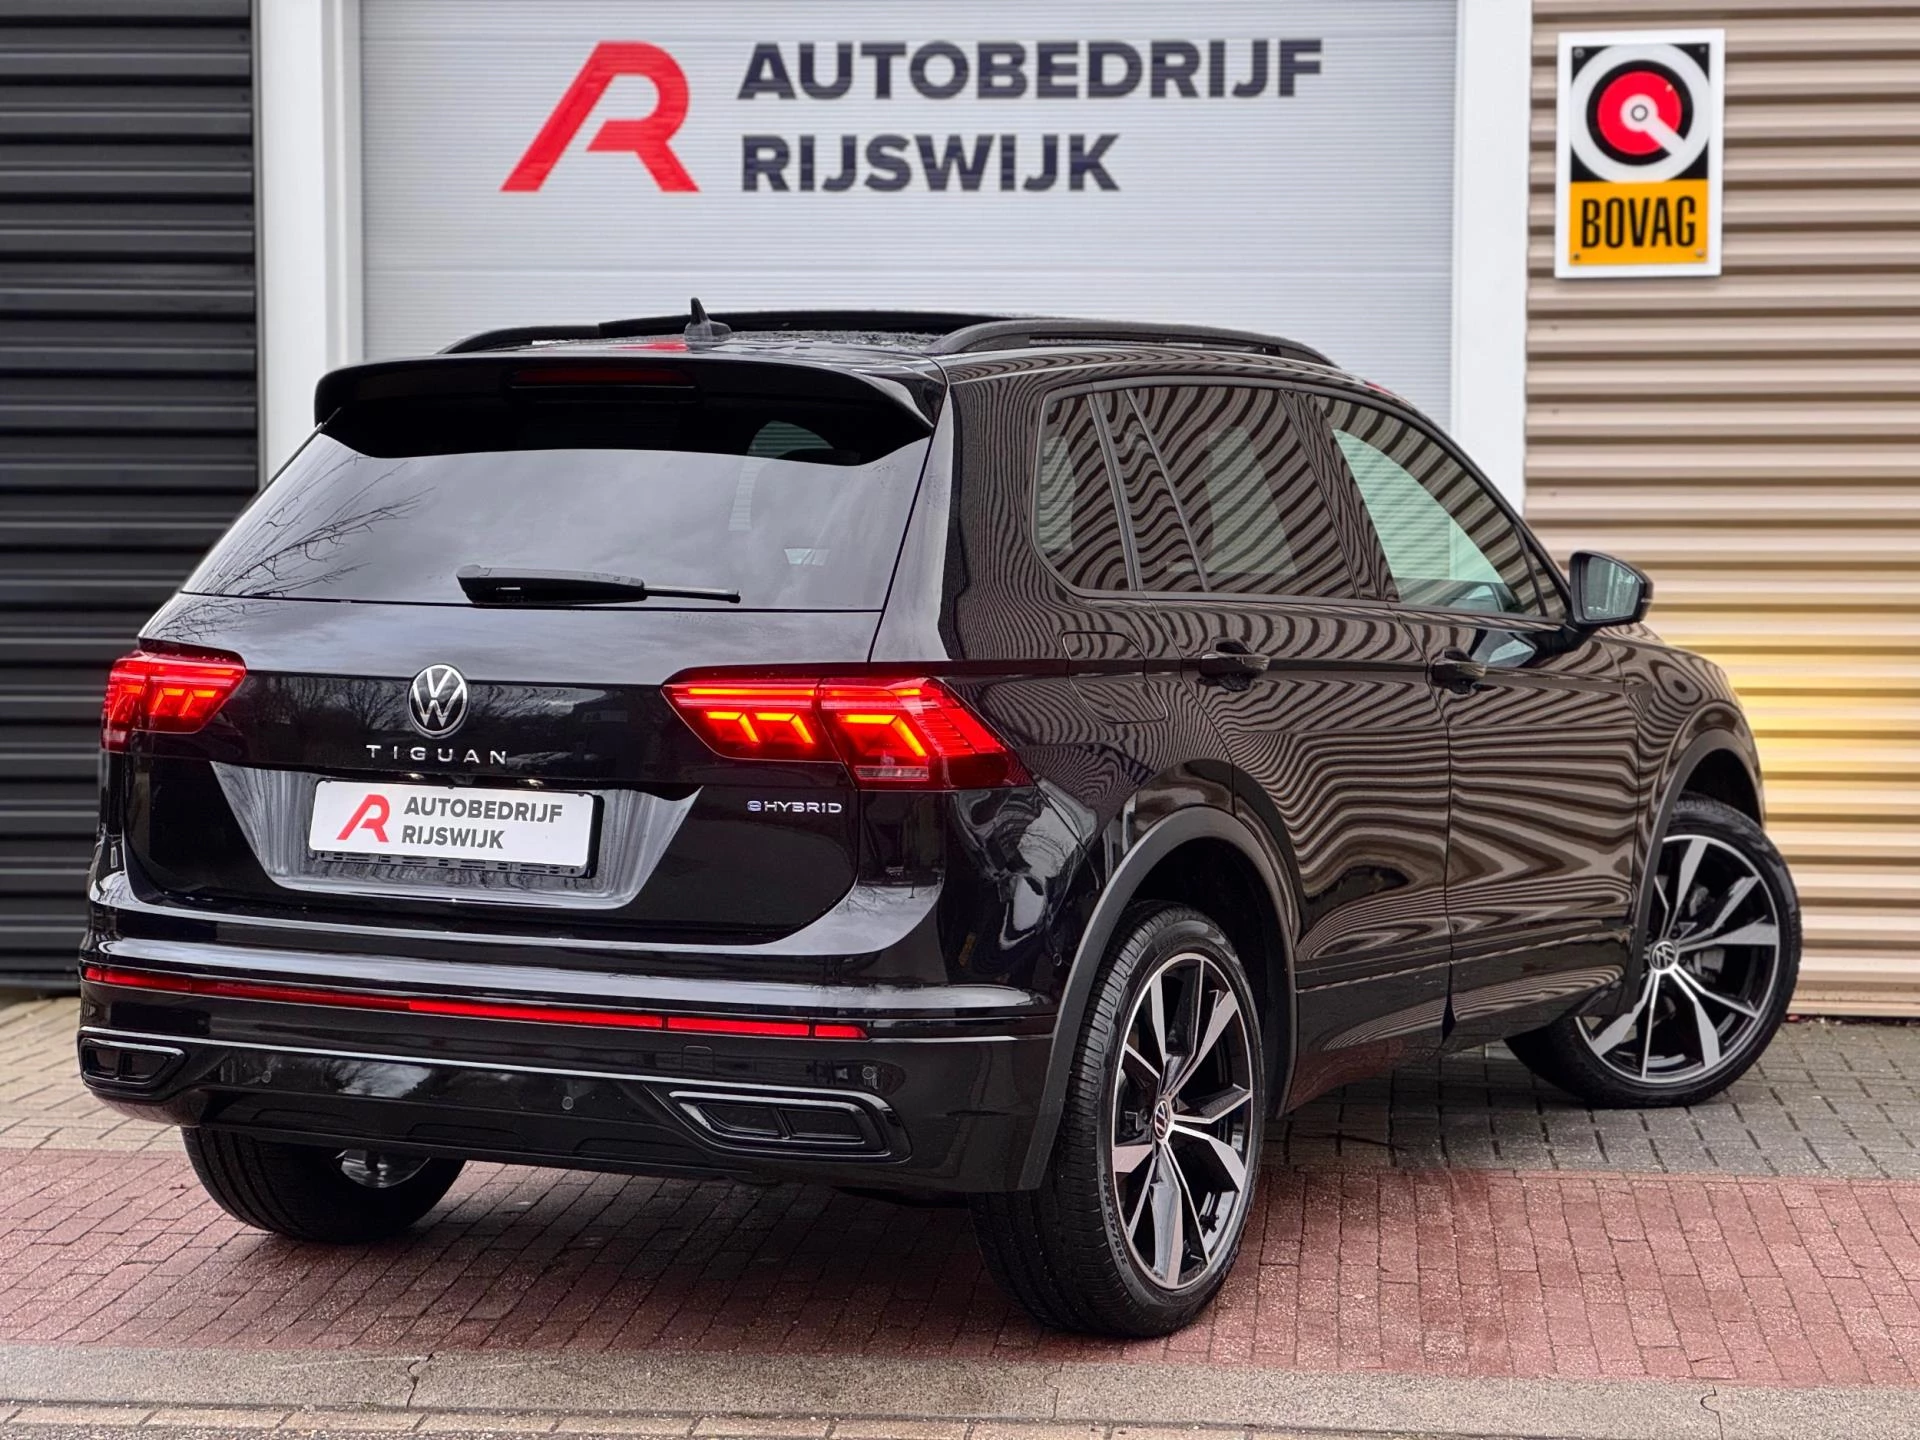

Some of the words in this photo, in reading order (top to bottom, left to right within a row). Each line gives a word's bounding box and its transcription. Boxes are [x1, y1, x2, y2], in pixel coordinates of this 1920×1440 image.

[737, 39, 1323, 101] AUTOBEDRIJF
[741, 134, 1121, 193] RIJSWIJK
[1581, 195, 1696, 248] BOVAG
[366, 744, 508, 766] TIGUAN
[403, 796, 563, 824] AUTOBEDRIJF
[401, 825, 504, 850] RIJSWIJK
